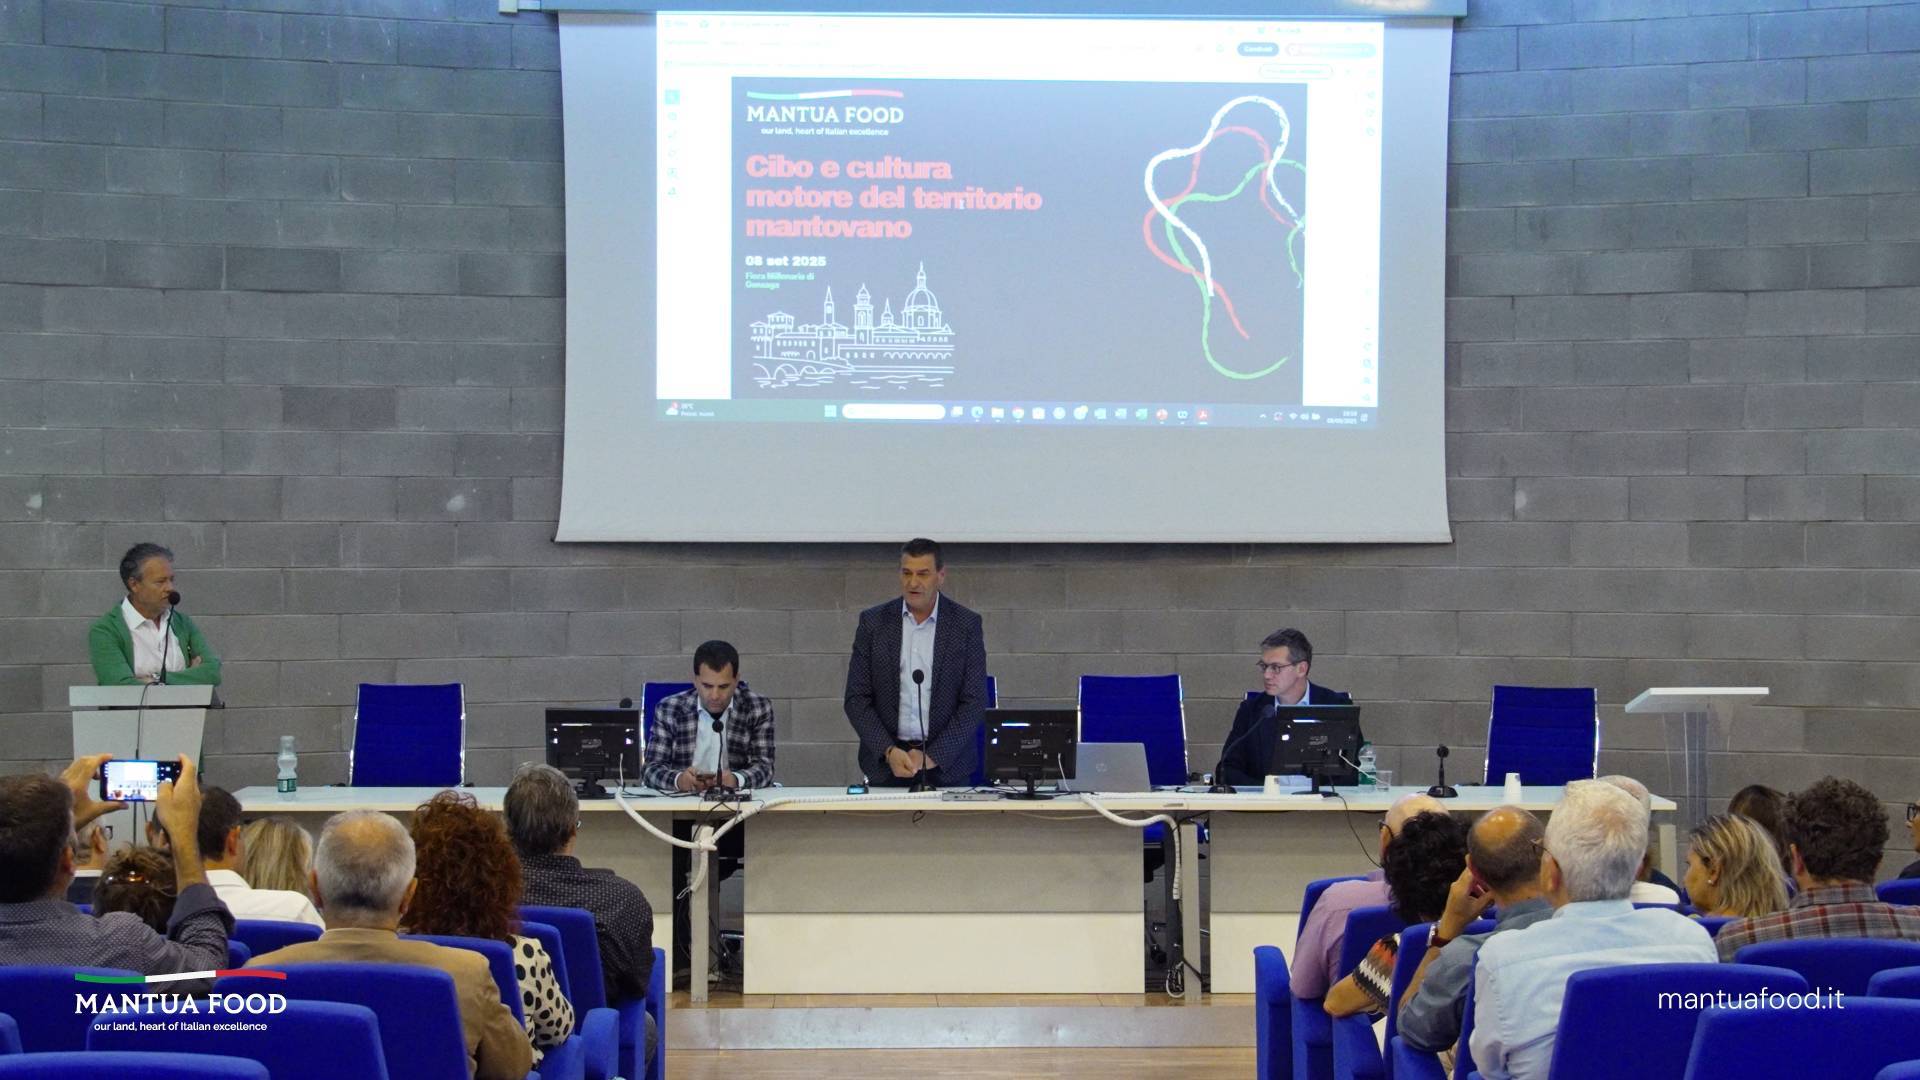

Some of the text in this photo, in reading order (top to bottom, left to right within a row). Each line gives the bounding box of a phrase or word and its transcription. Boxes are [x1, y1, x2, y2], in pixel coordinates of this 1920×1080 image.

[746, 105, 904, 124] MANTUA FOOD
[746, 154, 953, 180] Cibo e cultura
[746, 184, 1042, 210] motore del territorio
[746, 215, 912, 238] mantovano
[766, 255, 789, 267] set
[792, 255, 827, 267] 2025
